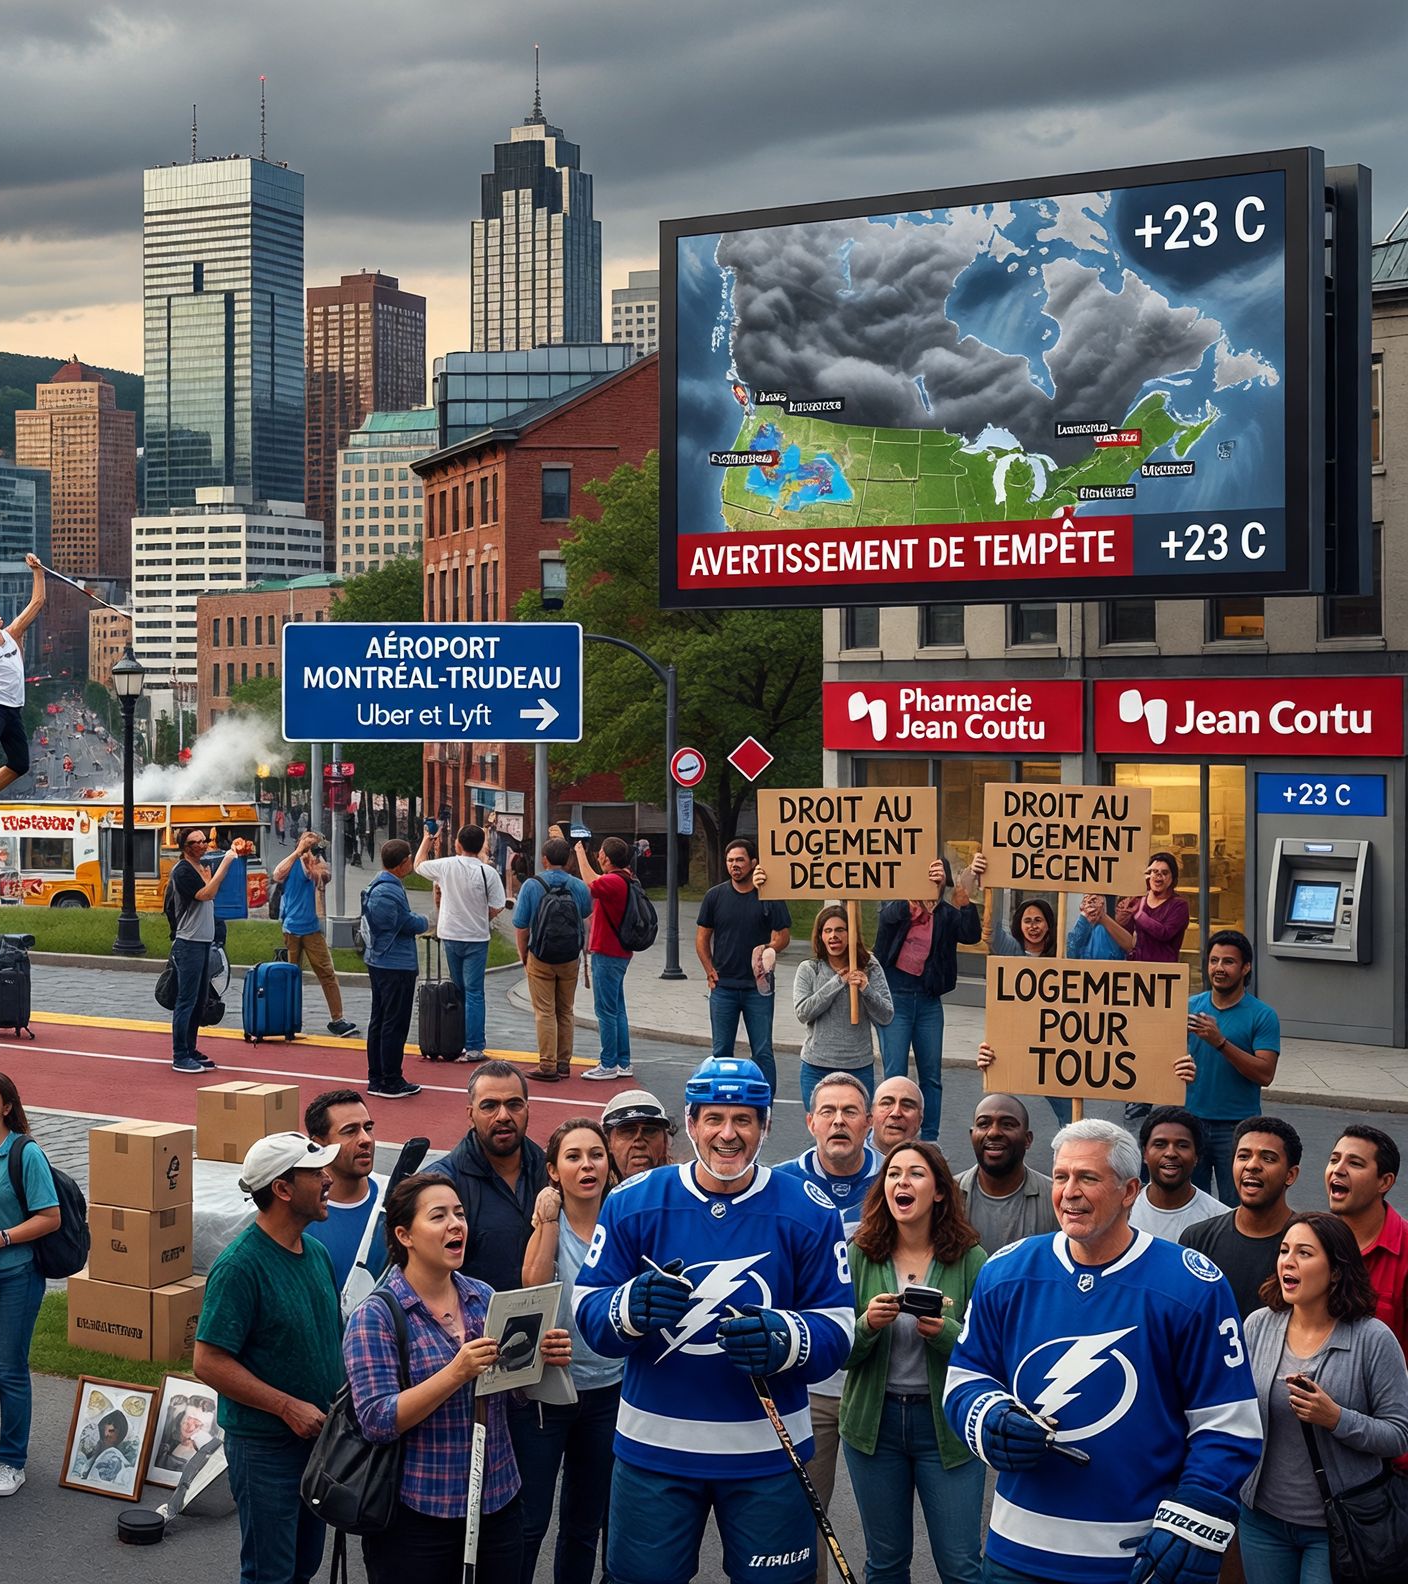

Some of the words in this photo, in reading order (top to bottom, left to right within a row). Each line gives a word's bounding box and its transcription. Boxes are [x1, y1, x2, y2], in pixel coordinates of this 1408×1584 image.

[1134, 201, 1218, 250] +23
[1235, 196, 1266, 243] C
[689, 538, 919, 576] AVERTISSEMENT
[928, 536, 965, 568] DE
[973, 519, 1115, 566] TEMPÊTE
[1160, 523, 1229, 561] +23
[1241, 521, 1266, 560] C
[365, 630, 501, 659] AÉROPORT
[303, 661, 561, 689] MONTRÉAL-TRUDEAU
[357, 703, 414, 726] Uber
[419, 704, 442, 726] et
[449, 703, 492, 732] Lyft
[899, 687, 1032, 712] Pharmacie
[1175, 700, 1260, 735] Jean
[1269, 700, 1372, 735] Cortu
[896, 713, 958, 739] Jean
[964, 713, 1045, 740] Coutu
[779, 795, 863, 824] DROIT
[873, 795, 912, 823] AU
[1004, 790, 1084, 819] DROIT
[1091, 794, 1129, 822] AU
[1283, 783, 1328, 806] +23
[1335, 784, 1351, 806] C
[770, 827, 923, 857] LOGEMENT
[992, 821, 1142, 853] LOGEMENT
[789, 853, 902, 890] DÉCENT
[1011, 846, 1120, 884] DÉCENT
[997, 966, 1181, 1009] LOGEMENT
[1039, 1008, 1129, 1047] POUR
[1028, 1046, 1137, 1091] TOUS
[583, 1223, 607, 1269] 8
[833, 1240, 852, 1285] 8
[1217, 1316, 1245, 1369] 3
